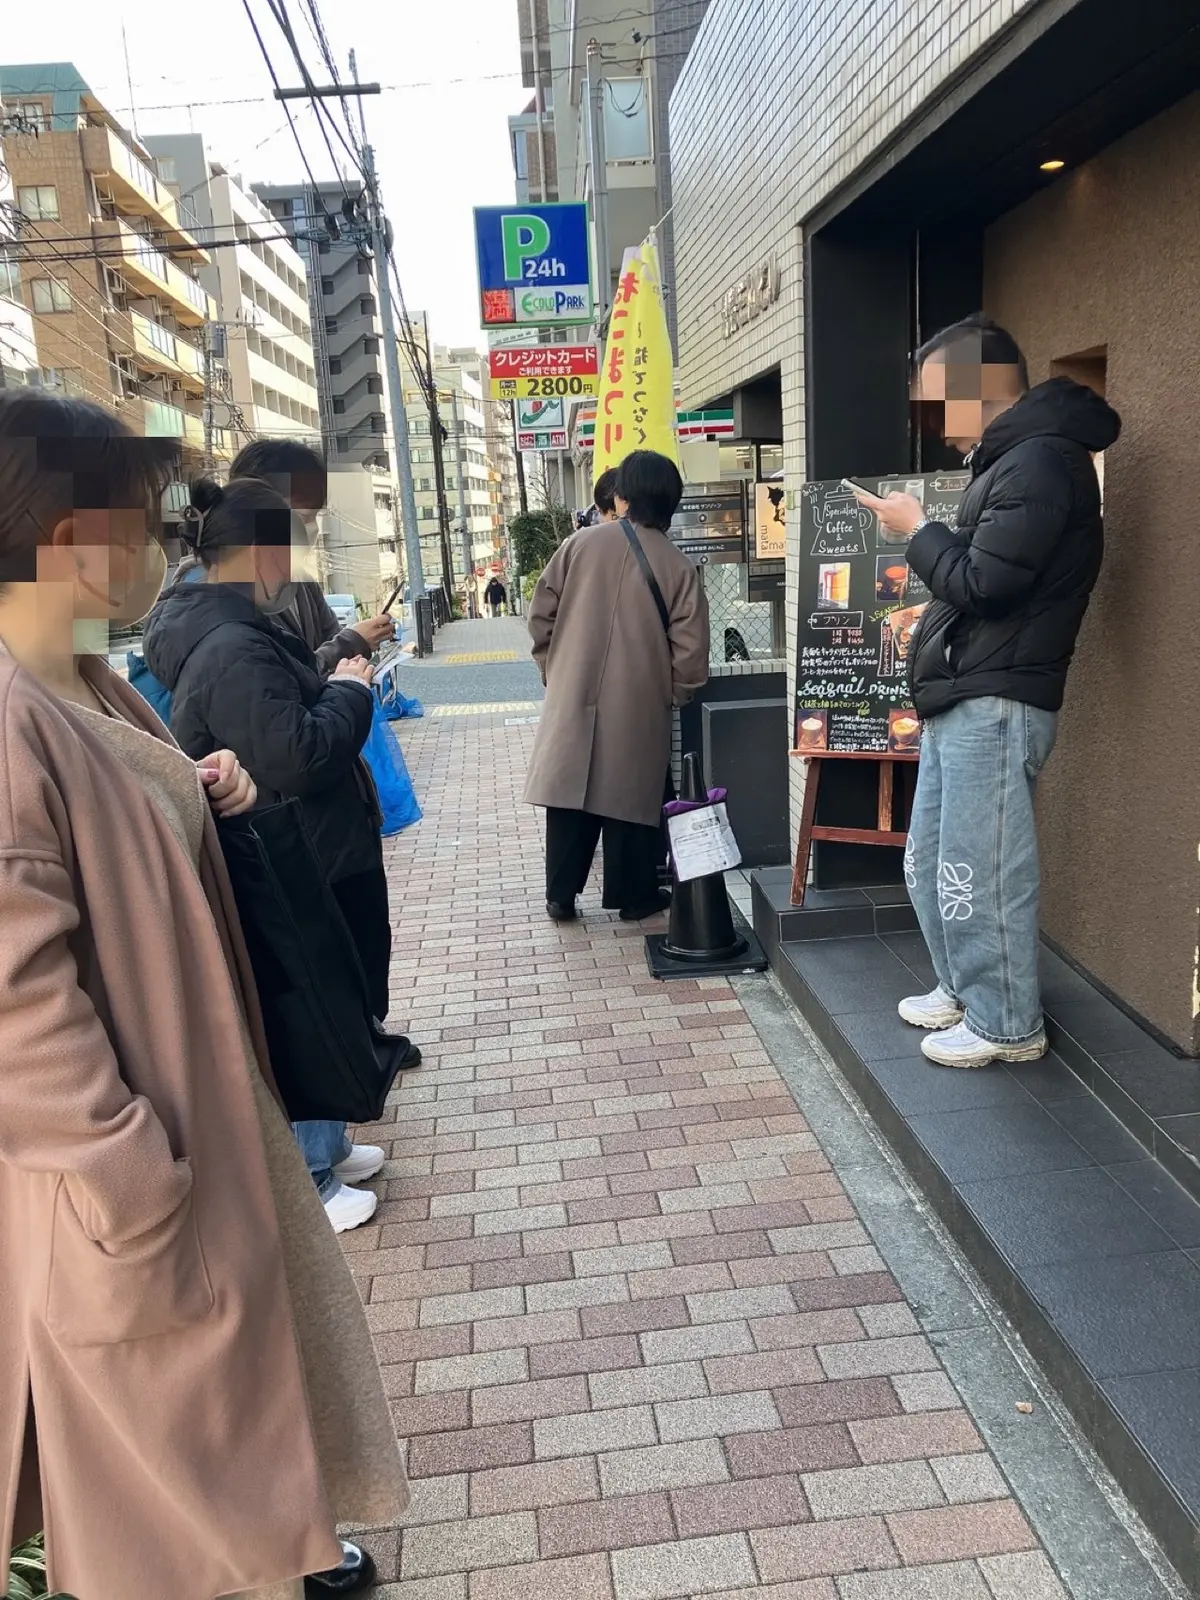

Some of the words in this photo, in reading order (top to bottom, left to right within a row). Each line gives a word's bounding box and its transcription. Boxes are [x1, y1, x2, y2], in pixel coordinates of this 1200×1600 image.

[501, 214, 551, 281] P
[525, 258, 566, 278] 24h
[495, 348, 596, 366] クレジットカード
[519, 366, 573, 376] ご利用できます
[552, 433, 565, 445] ATM
[943, 479, 970, 490] ホット
[826, 521, 853, 533] Coffee
[769, 541, 786, 550] ma
[818, 540, 858, 554] Sweets
[823, 616, 850, 625] プリン
